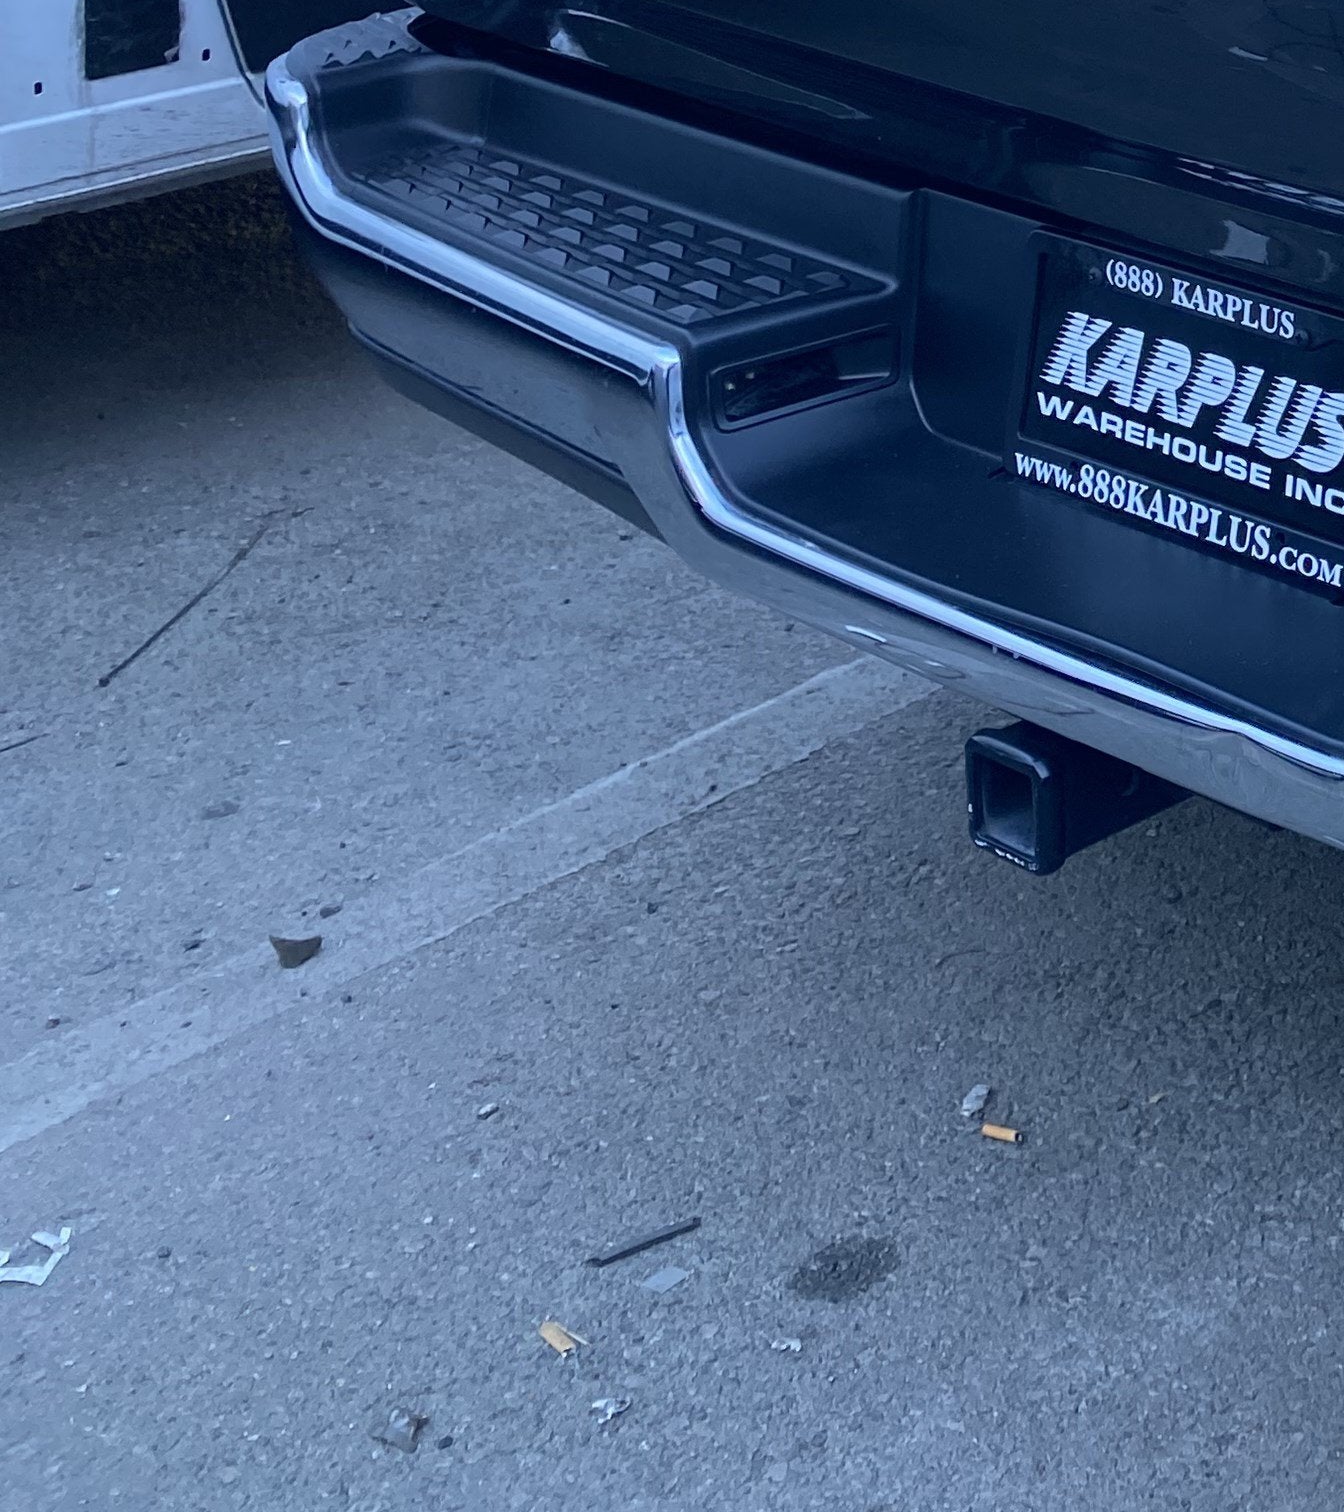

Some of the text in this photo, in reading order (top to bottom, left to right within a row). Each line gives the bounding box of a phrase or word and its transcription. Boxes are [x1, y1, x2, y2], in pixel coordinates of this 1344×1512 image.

[1105, 259, 1296, 339] (888) KARPLUS
[1036, 391, 1271, 490] WAREHOUSE
